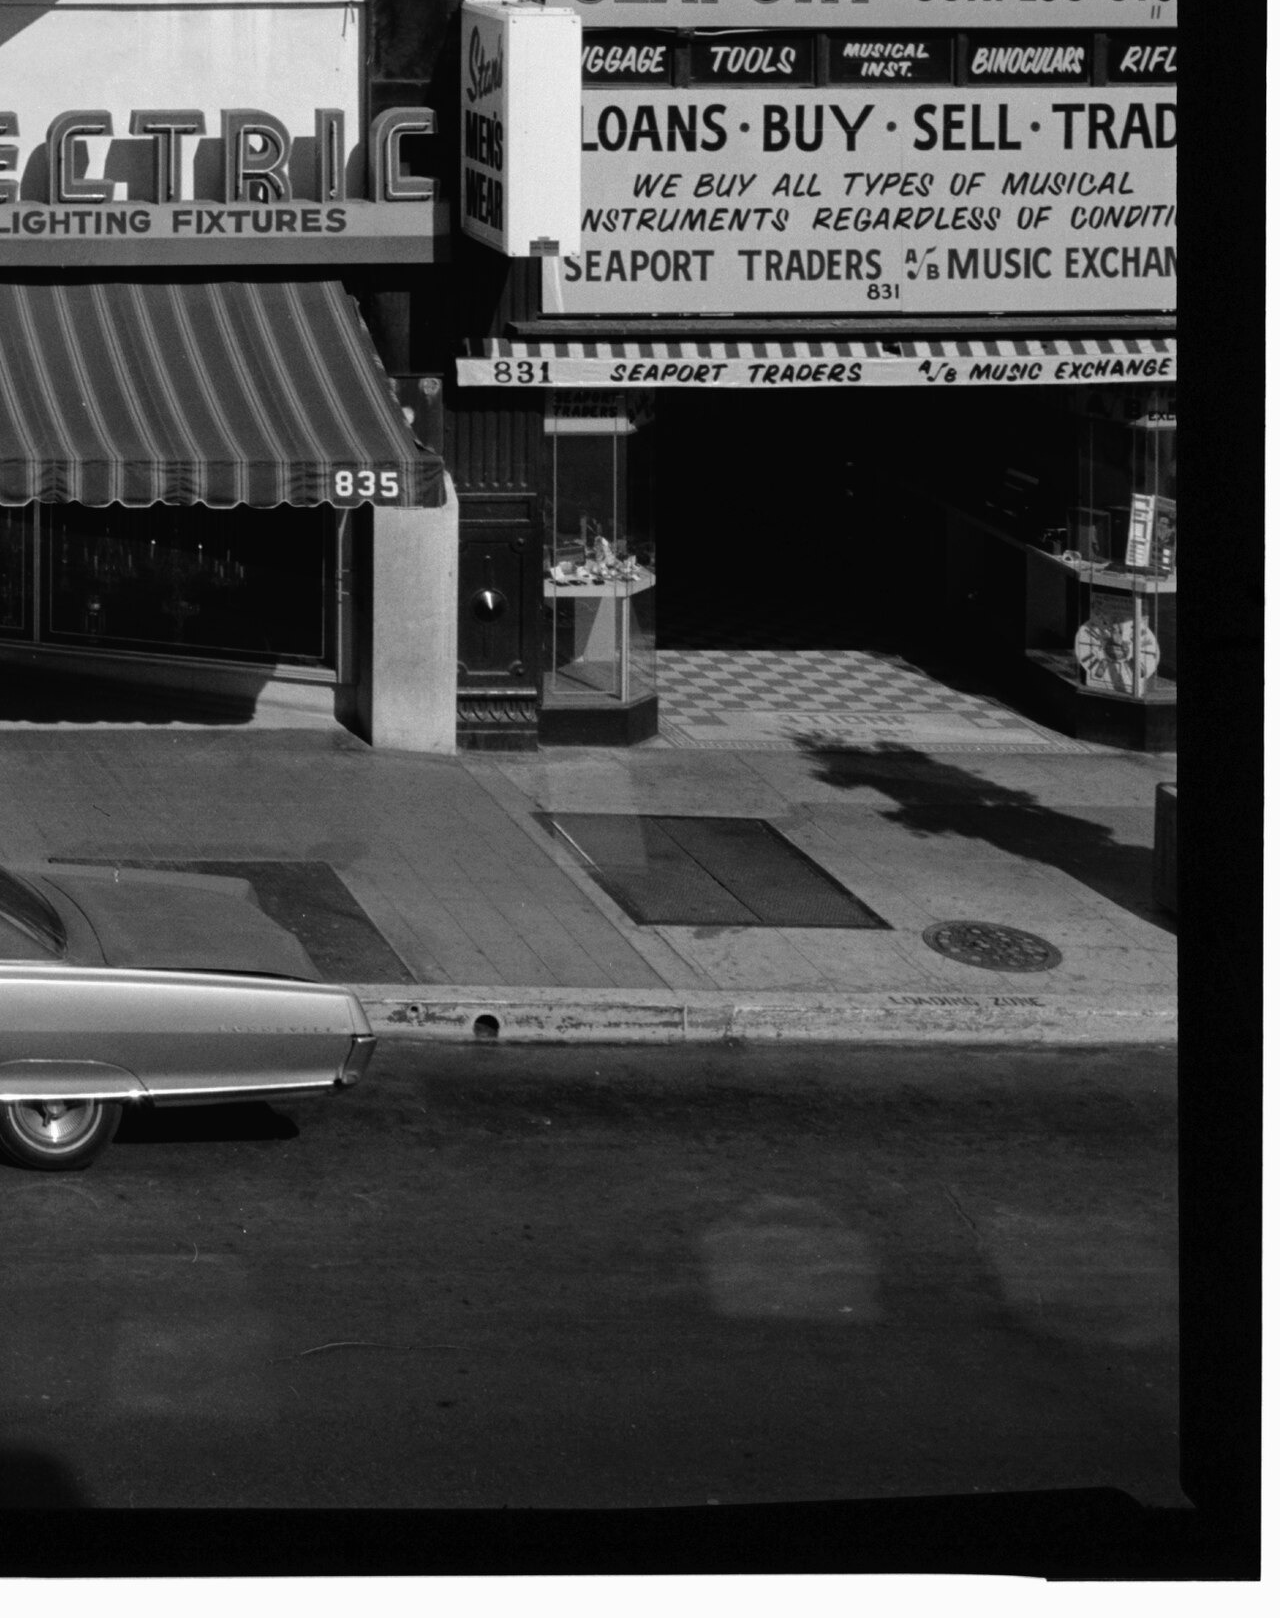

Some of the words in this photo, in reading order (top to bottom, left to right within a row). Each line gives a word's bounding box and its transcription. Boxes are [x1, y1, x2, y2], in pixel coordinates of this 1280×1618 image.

[710, 46, 796, 74] TOOLS
[842, 42, 930, 59] MUSICAL
[971, 46, 1085, 75] BINOCULARS
[860, 60, 913, 77] INST.
[465, 109, 504, 172] MEN'S
[763, 104, 876, 152] BUY
[913, 103, 1022, 151] SELL
[633, 173, 683, 198] WE
[693, 173, 758, 198] BUY
[771, 173, 822, 197] ALL
[843, 171, 935, 197] TYPES
[950, 171, 986, 197] OF
[1001, 171, 1135, 197] MUSICAL
[465, 166, 504, 232] WEAR
[172, 208, 348, 234] FIXTURES
[812, 206, 1002, 232] REGARDLESS
[1017, 205, 1053, 231] OF
[1070, 204, 1177, 230] CONDITI
[563, 248, 716, 282] SEAPORT
[737, 248, 883, 281] TRADERS
[947, 246, 1053, 280] MUSIC
[866, 282, 901, 301] 831
[493, 360, 553, 385] 831
[609, 362, 728, 383] SEAPORT
[747, 362, 863, 383] TRADERS
[968, 362, 1043, 382] MUSIC
[1053, 357, 1173, 380] EXCHANGE
[334, 470, 400, 498] 835
